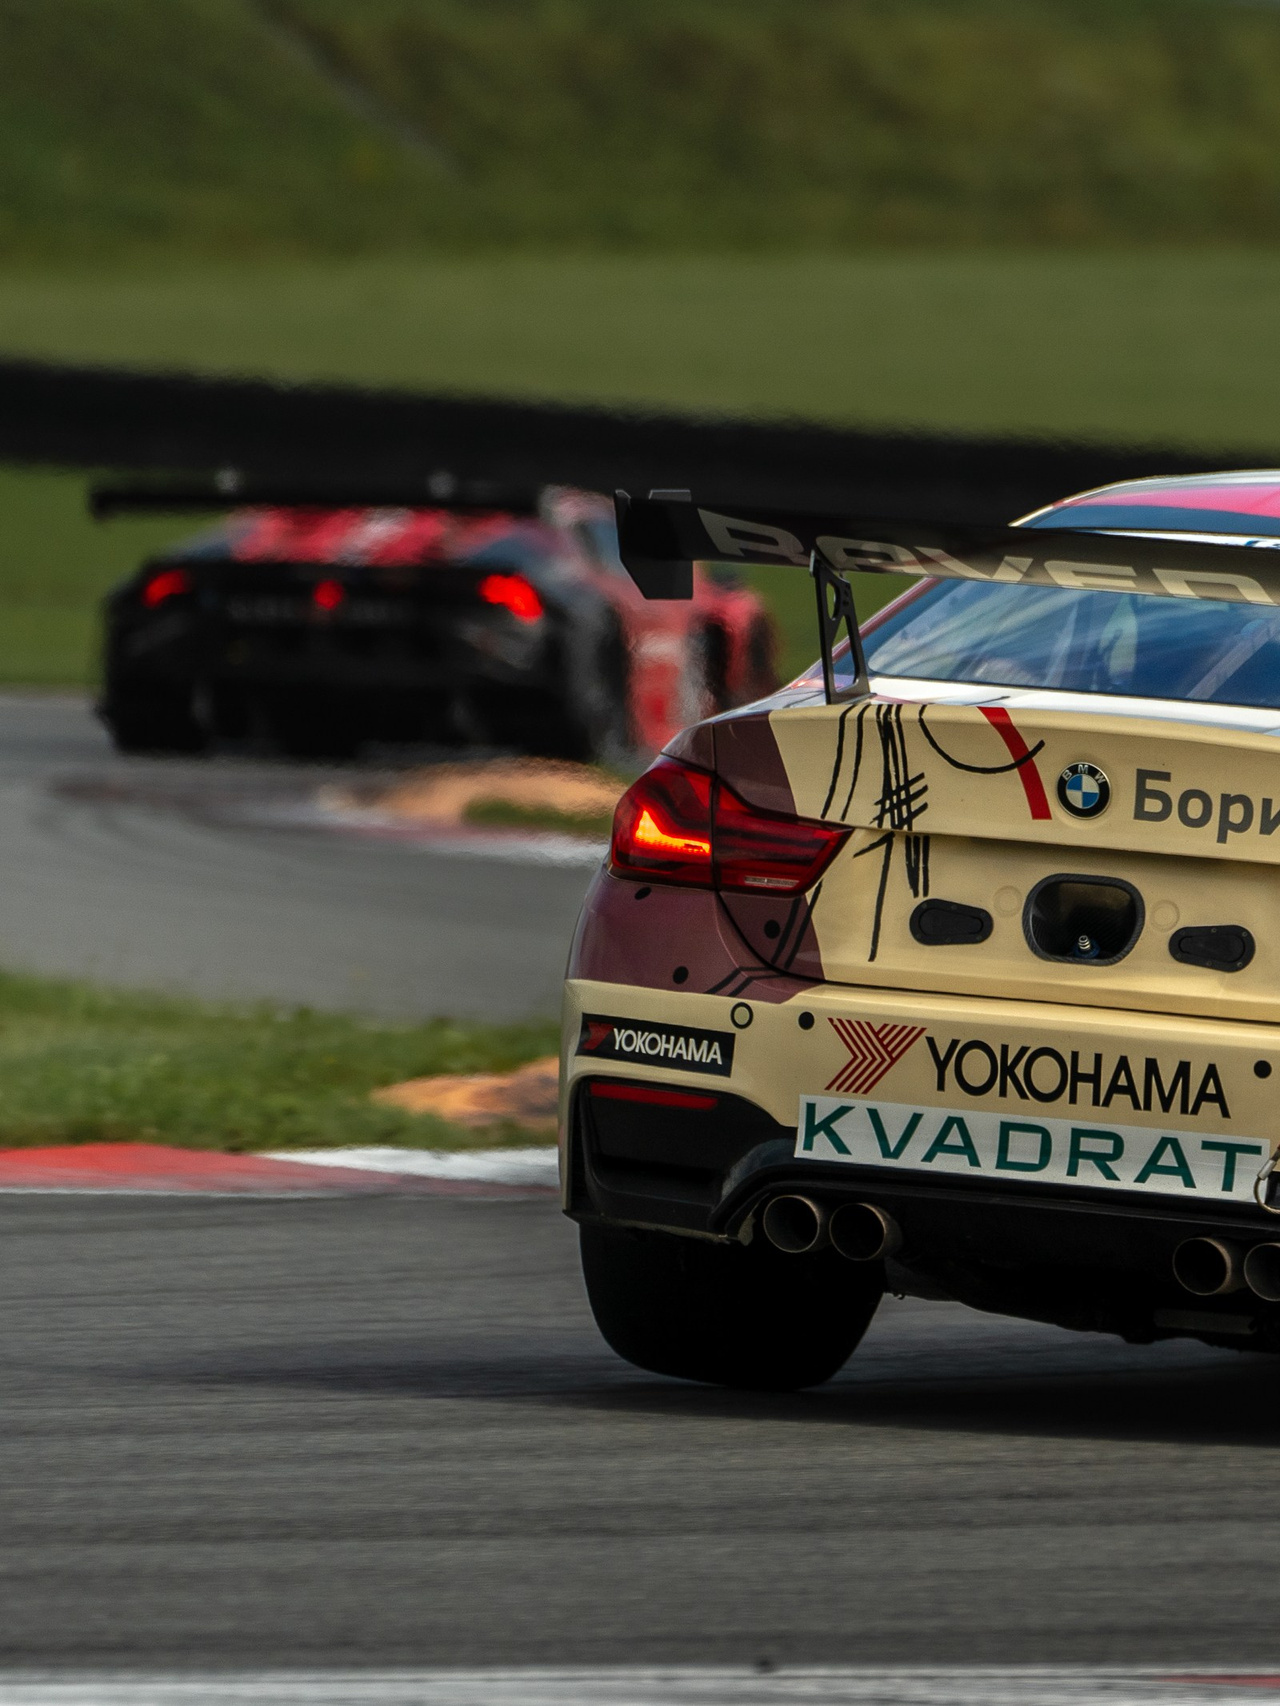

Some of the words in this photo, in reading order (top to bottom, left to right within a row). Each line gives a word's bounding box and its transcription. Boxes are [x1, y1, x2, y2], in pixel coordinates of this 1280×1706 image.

[1061, 764, 1107, 784] BMW
[611, 1027, 723, 1066] YOKOHAMA
[924, 1036, 1232, 1119] YOKOHAMA
[802, 1101, 1263, 1193] KVADRAT
